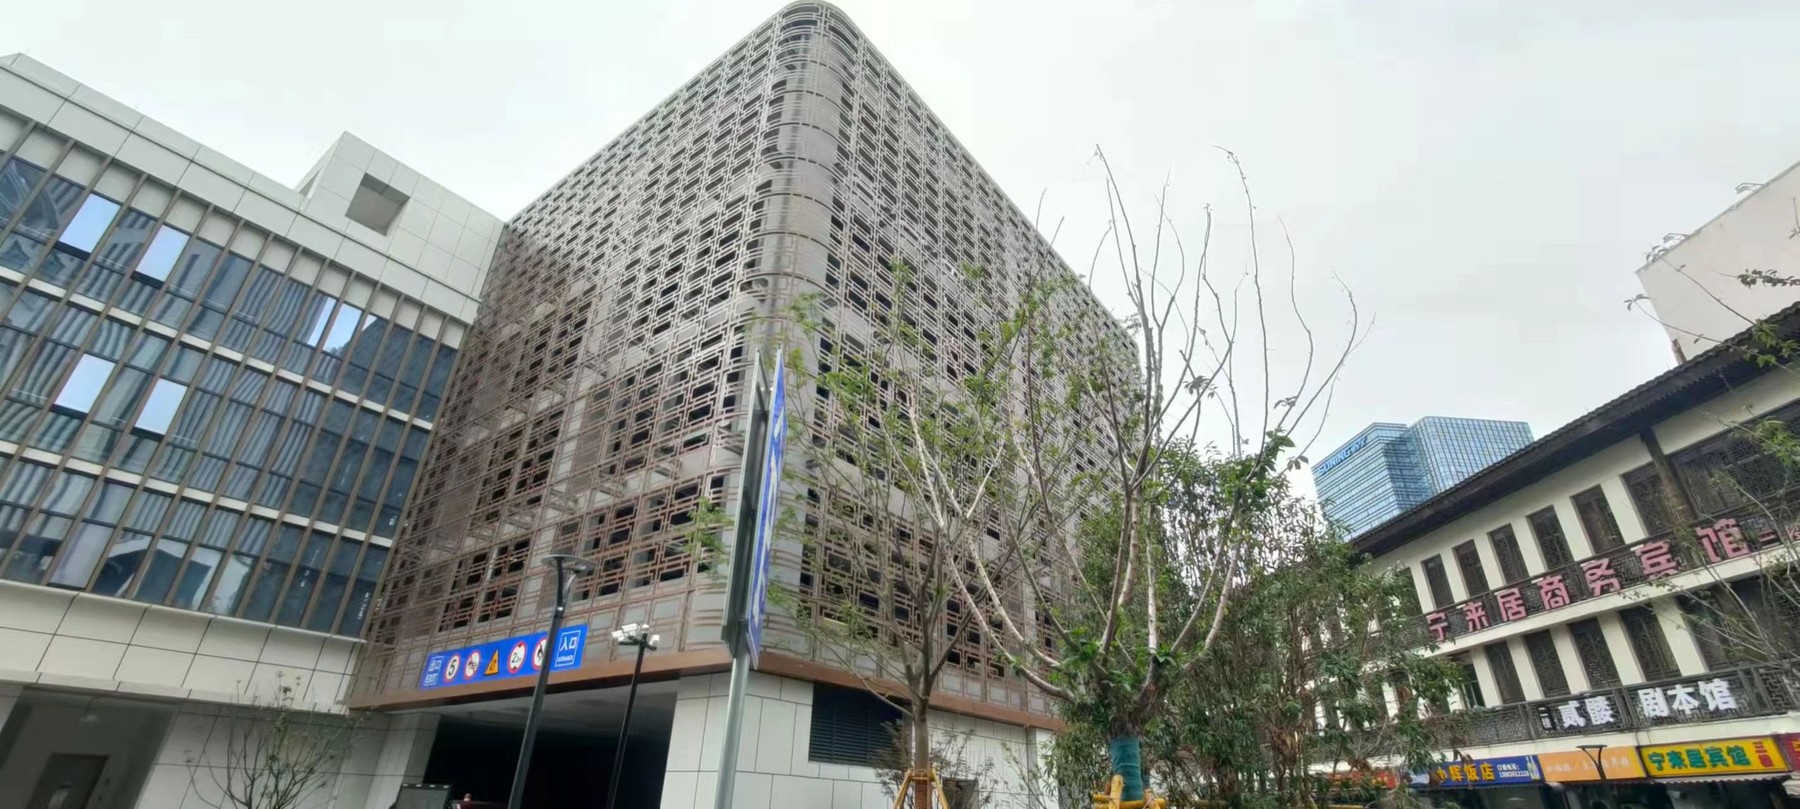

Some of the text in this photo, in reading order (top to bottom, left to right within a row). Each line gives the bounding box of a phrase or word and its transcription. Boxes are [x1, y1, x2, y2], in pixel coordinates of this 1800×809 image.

[1426, 518, 1749, 642] 宁来居商务宾馆
[560, 636, 578, 651] 入口
[448, 659, 457, 676] 5
[1637, 678, 1738, 718] 剧本馆
[1648, 745, 1751, 771] 宁来居宾馆
